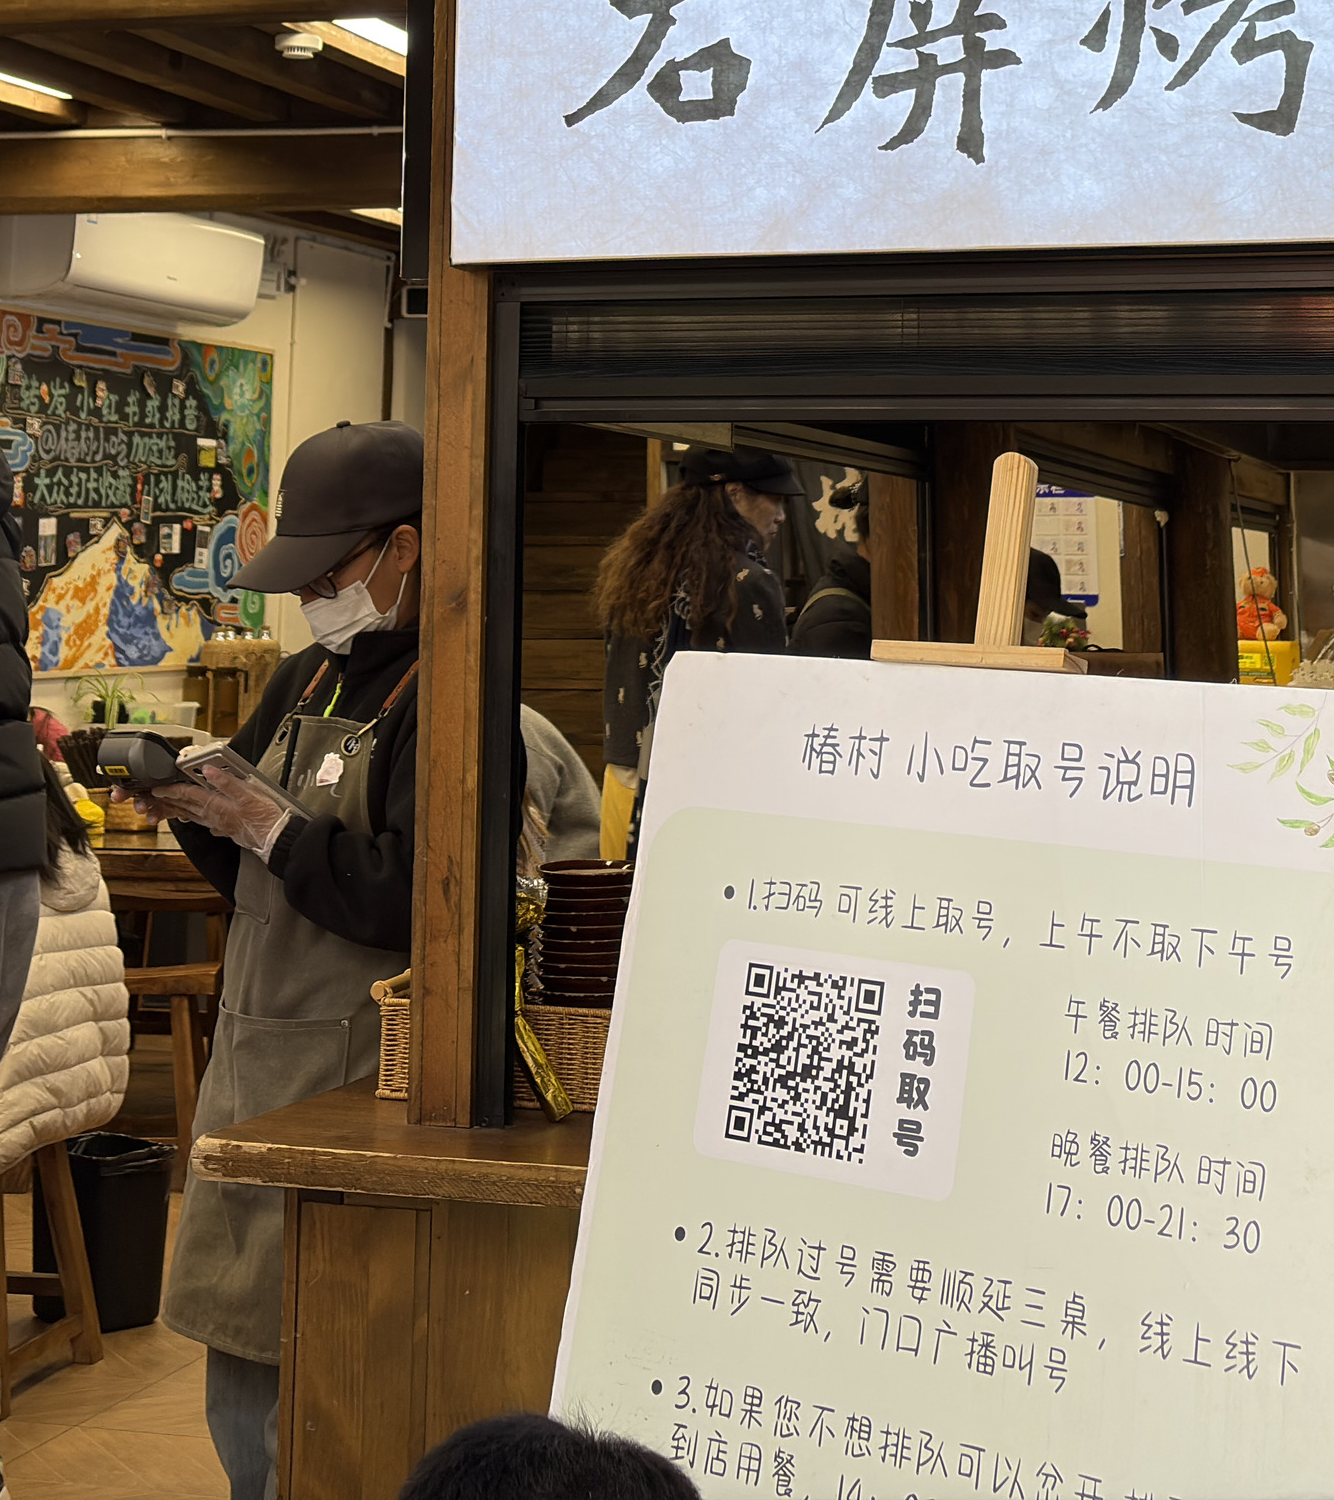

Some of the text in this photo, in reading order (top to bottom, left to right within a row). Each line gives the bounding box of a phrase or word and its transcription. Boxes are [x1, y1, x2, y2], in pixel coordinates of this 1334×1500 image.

[801, 722, 1195, 808] 椿村小吃取号说明
[892, 982, 942, 1158] 扫码取号
[1064, 994, 1273, 1061] 午餐排队时间
[1050, 1129, 1266, 1202] 晚餐排队时间
[674, 1375, 1181, 1500] 3.如果您不想排队可以岔开
